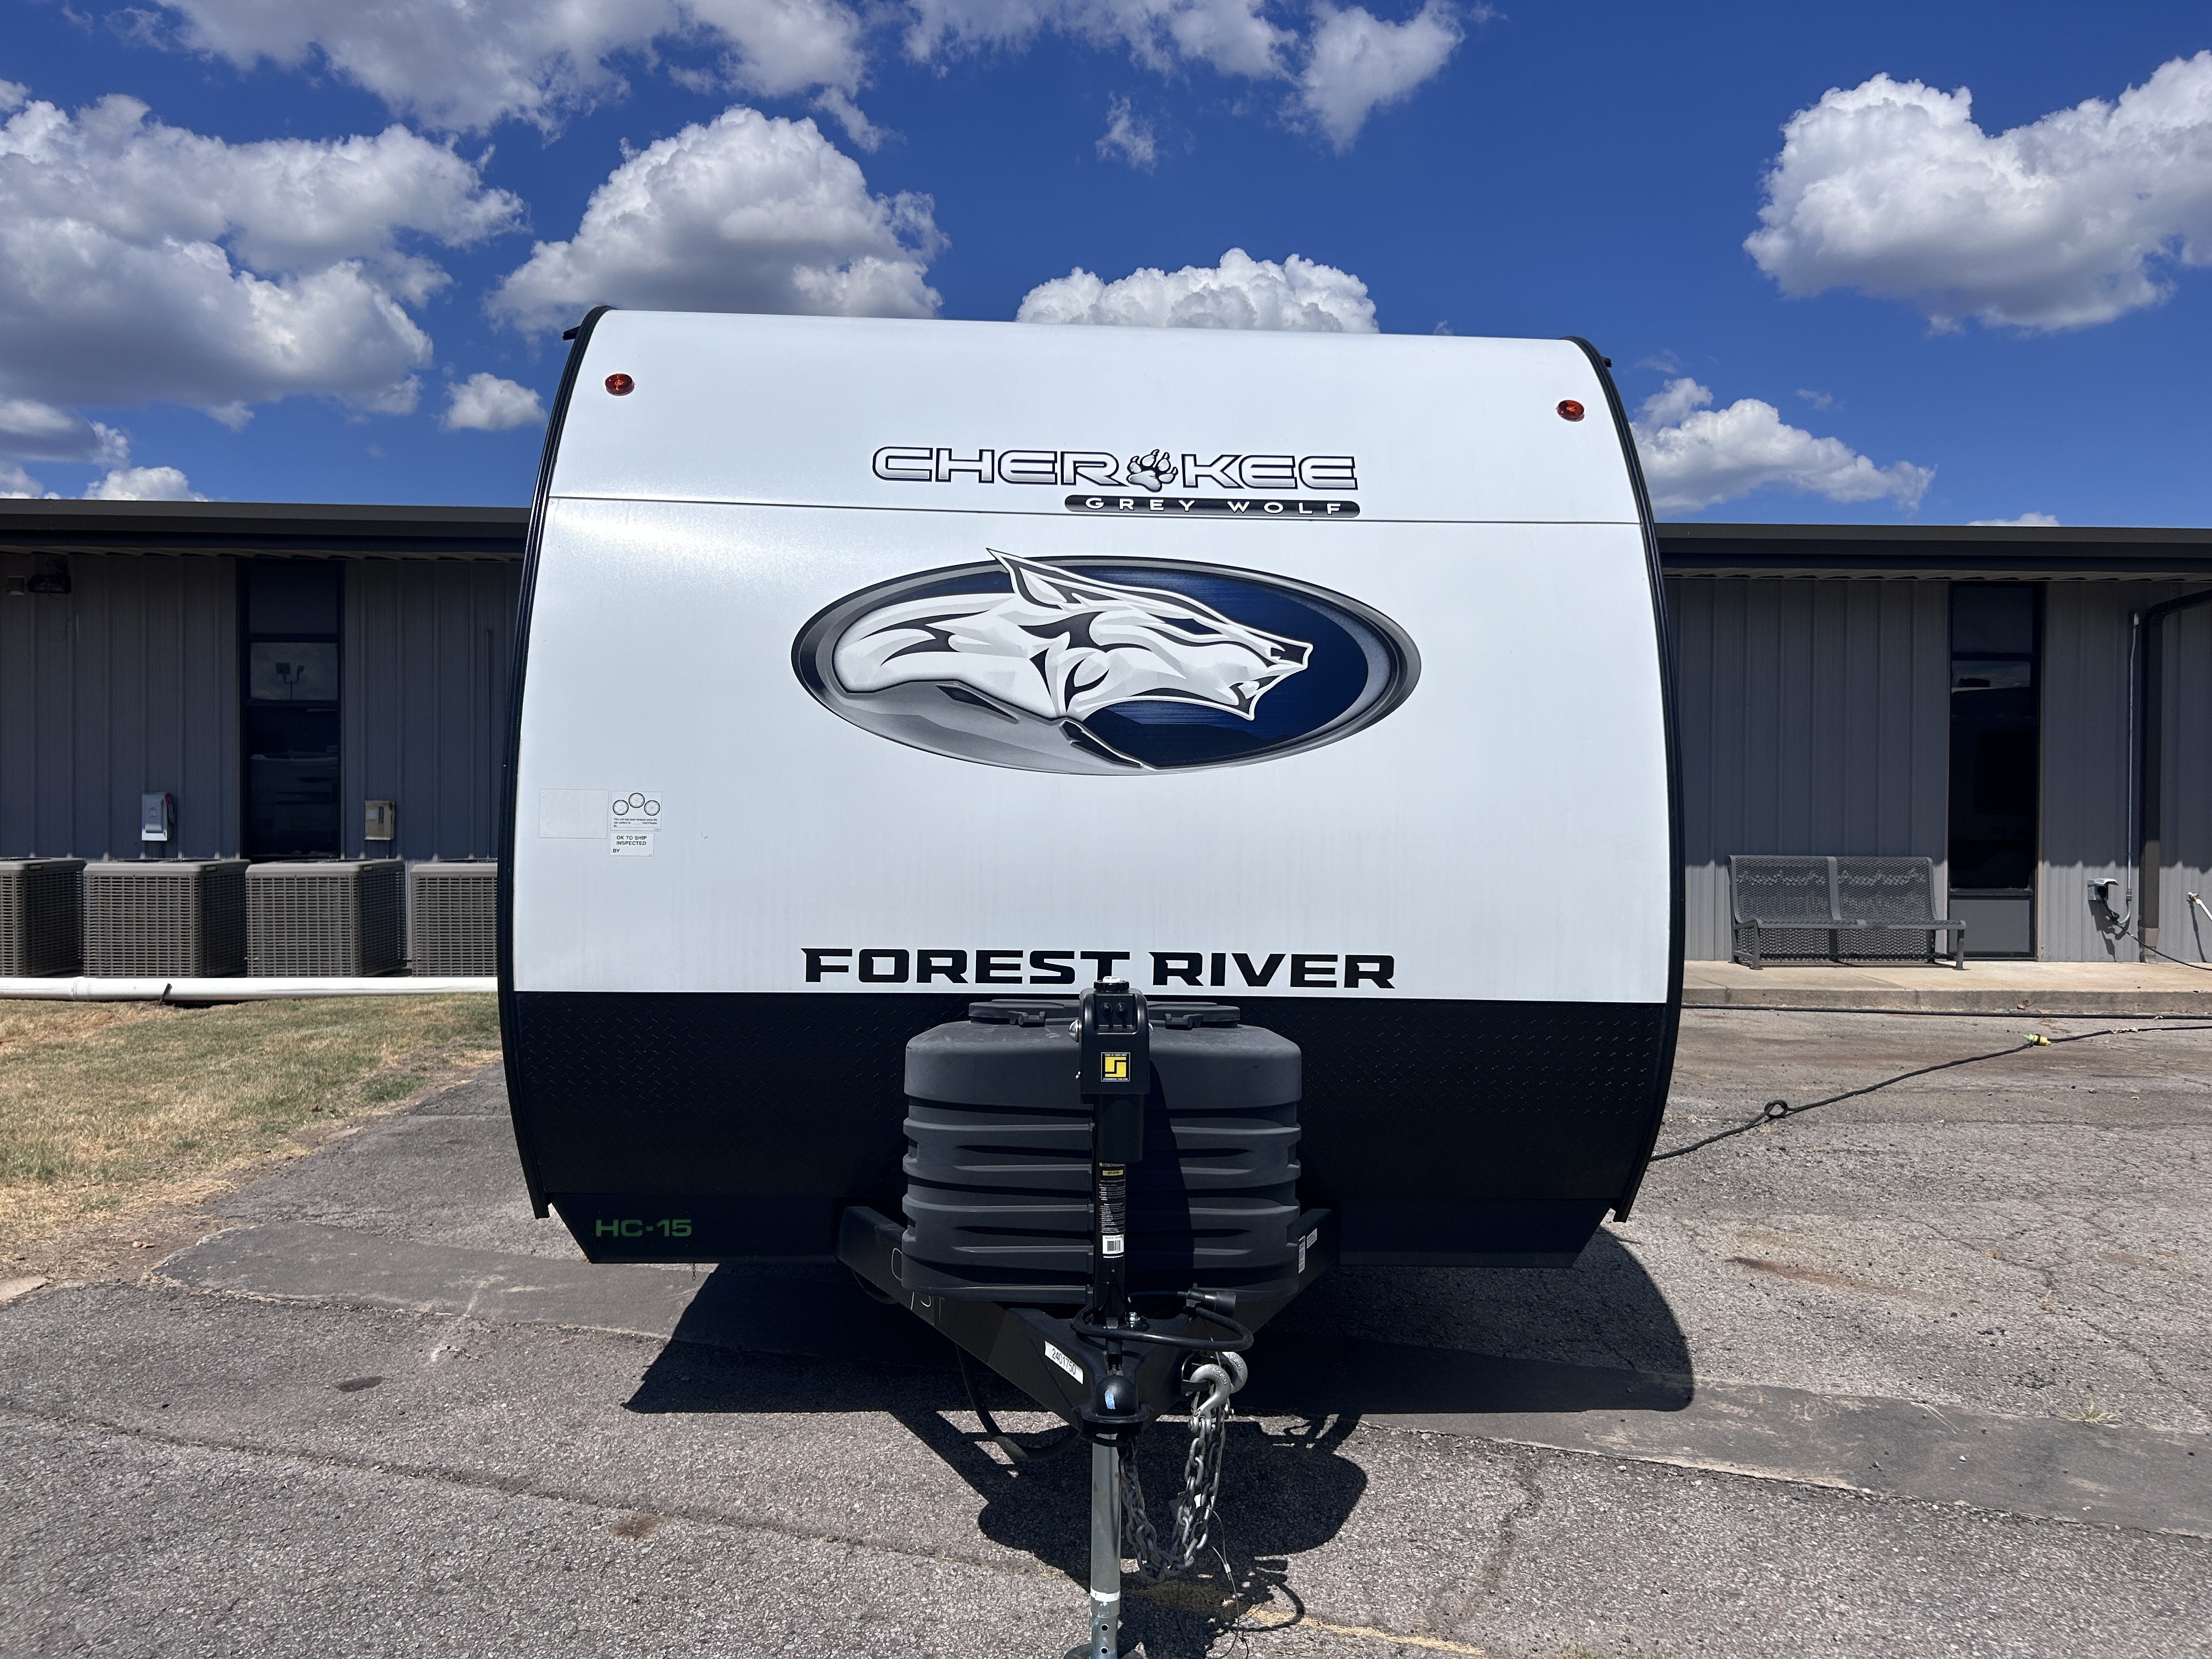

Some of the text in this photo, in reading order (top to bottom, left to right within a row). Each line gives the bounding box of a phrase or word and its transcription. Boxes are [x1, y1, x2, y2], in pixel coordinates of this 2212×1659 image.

[1085, 497, 1341, 515] GREY WOLF
[800, 947, 1396, 989] FOREST RIVER
[596, 1219, 692, 1237] HC-15
[1052, 1347, 1076, 1375] 2401750
